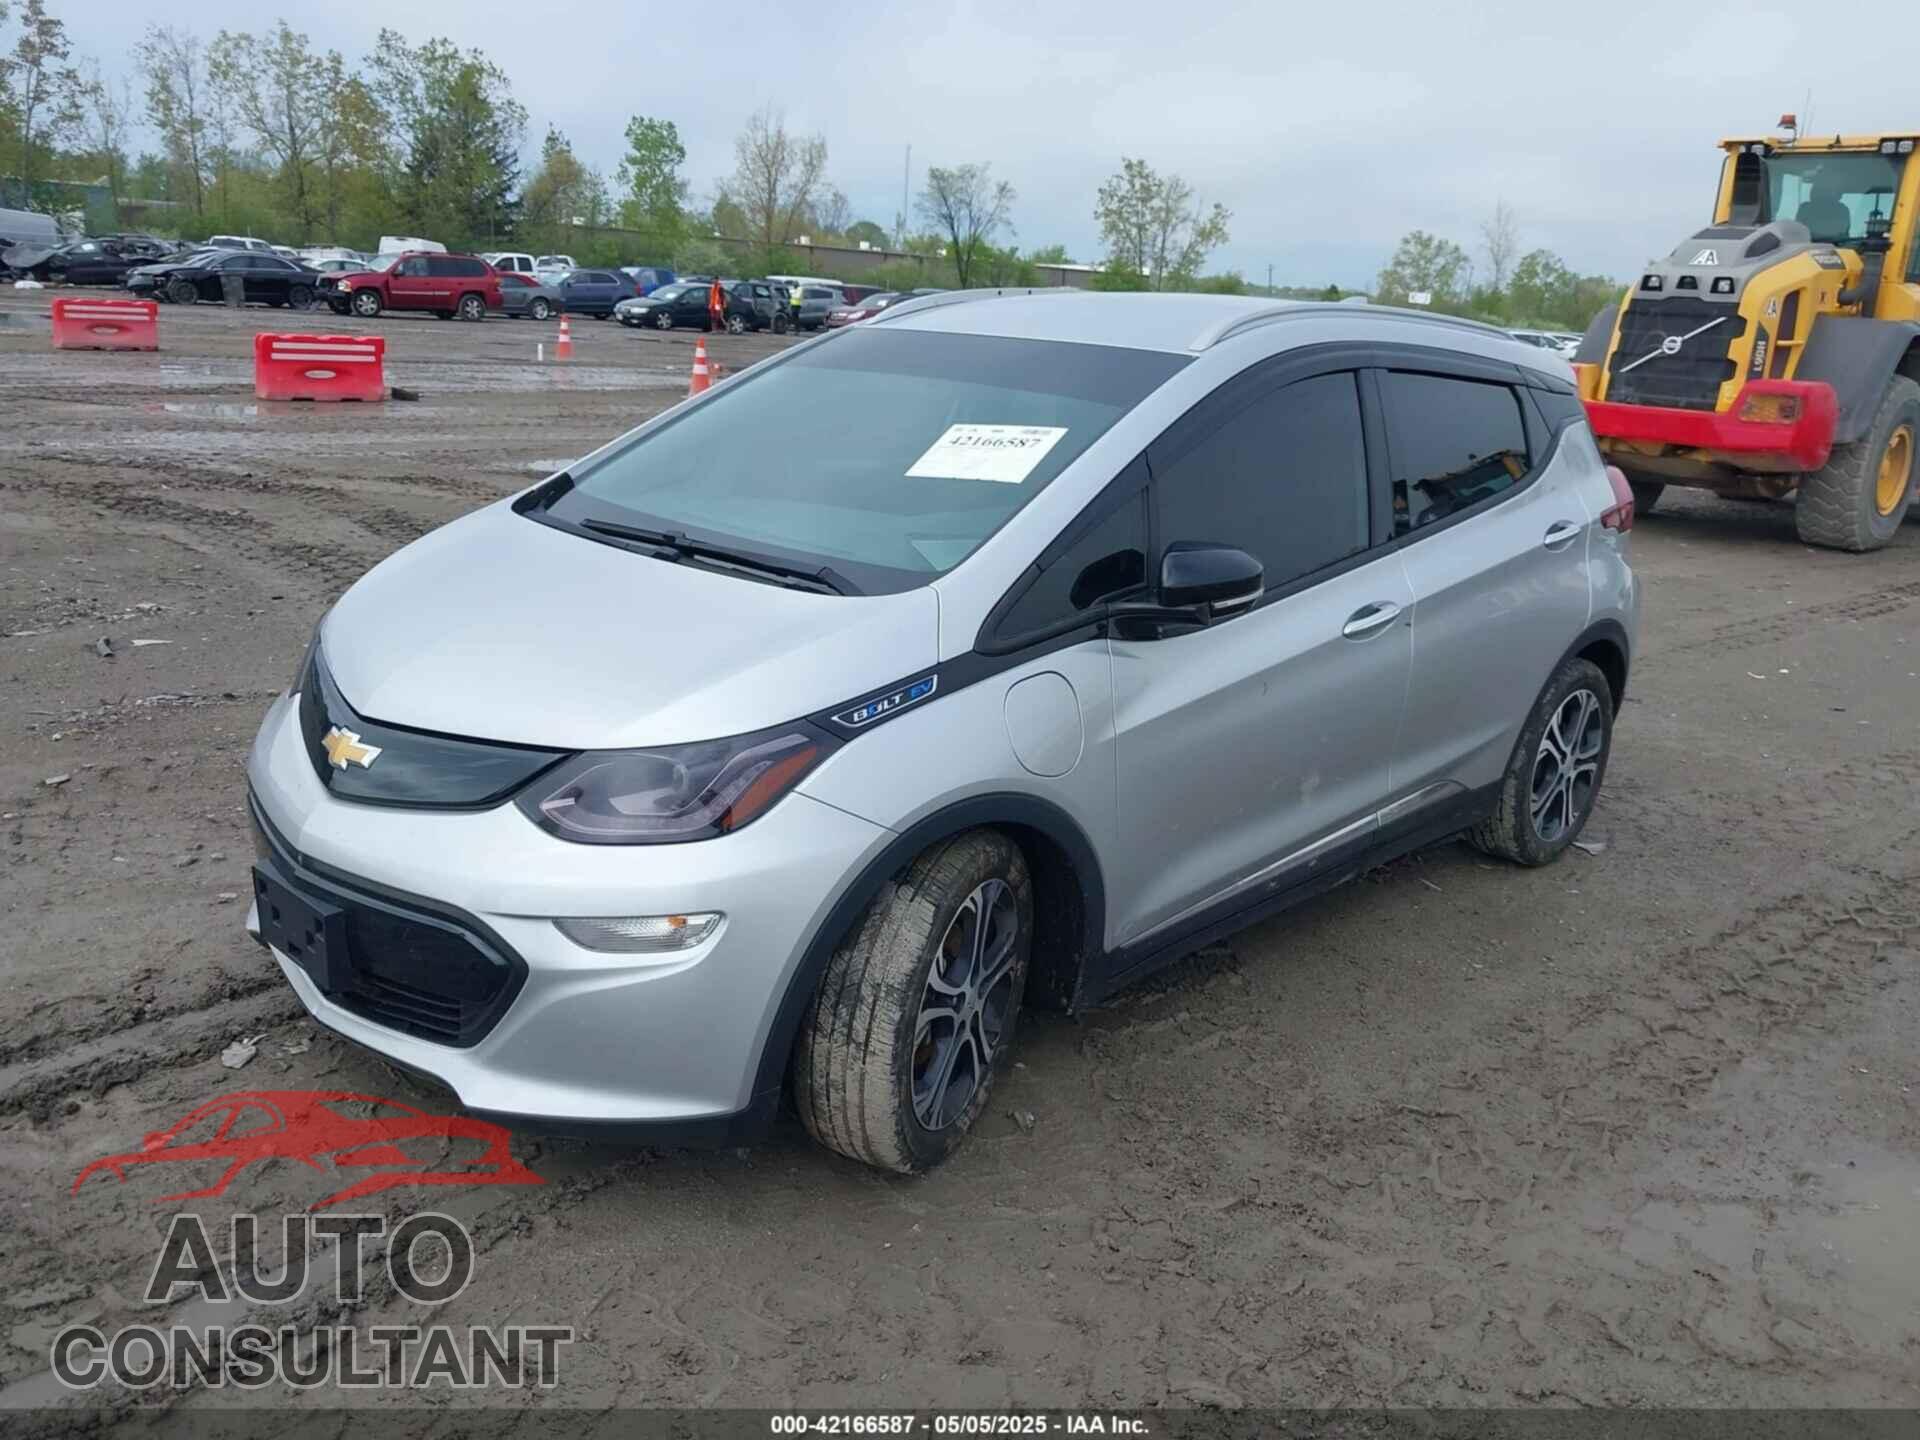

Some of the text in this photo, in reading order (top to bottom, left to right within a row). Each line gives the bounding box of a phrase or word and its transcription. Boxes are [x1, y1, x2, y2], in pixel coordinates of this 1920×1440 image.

[948, 435, 1042, 449] 42166587
[853, 680, 932, 722] BOLT EV
